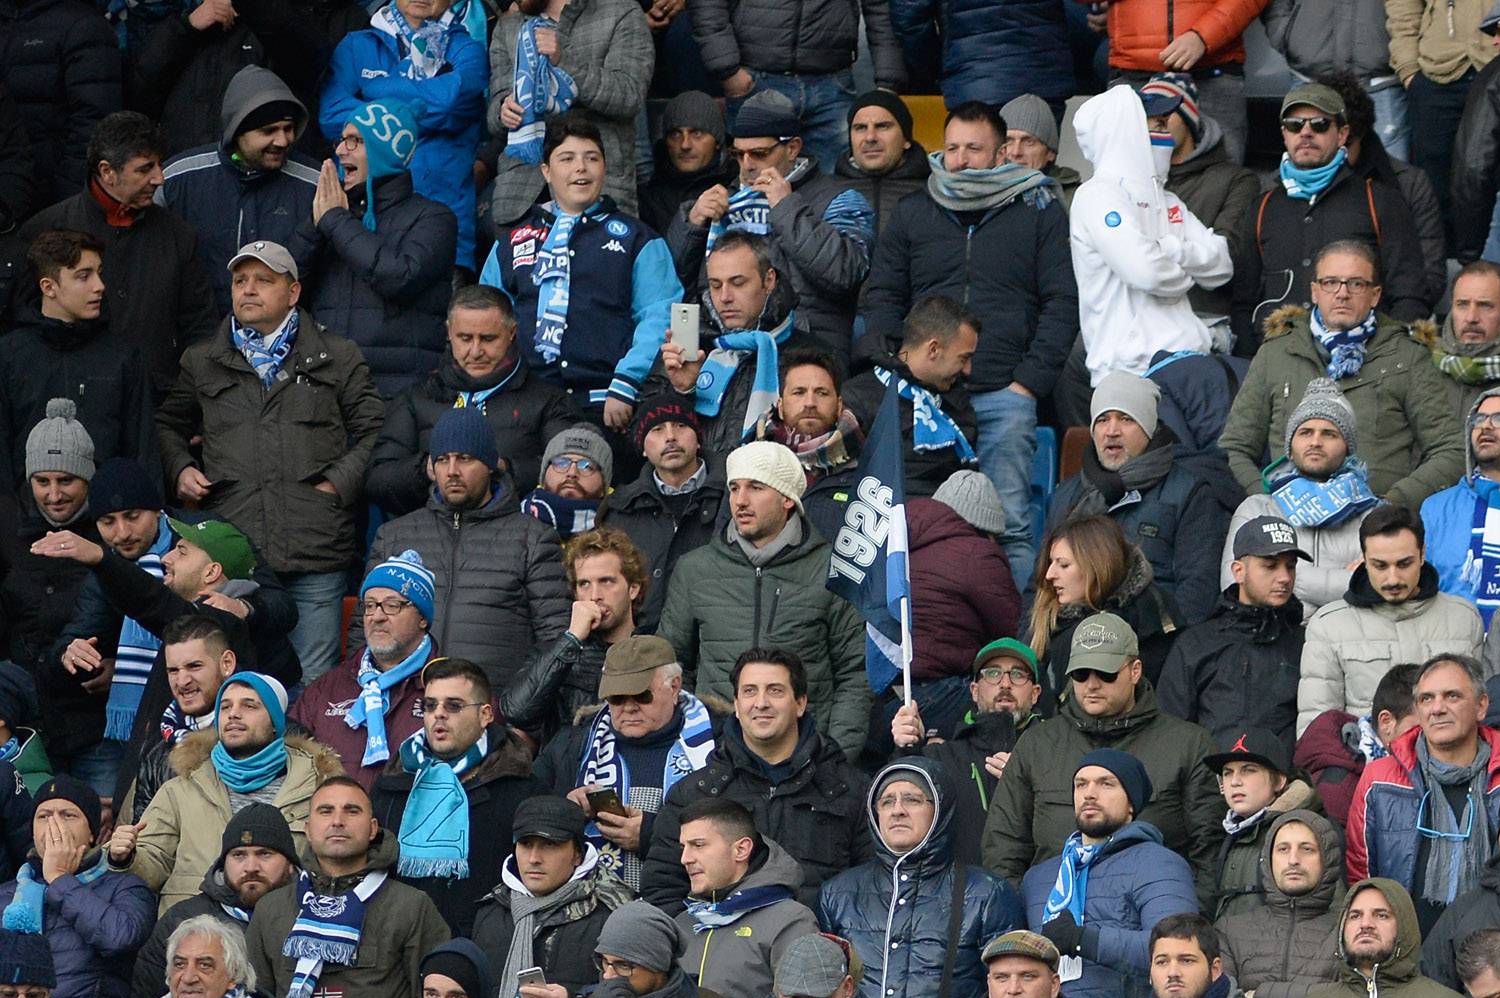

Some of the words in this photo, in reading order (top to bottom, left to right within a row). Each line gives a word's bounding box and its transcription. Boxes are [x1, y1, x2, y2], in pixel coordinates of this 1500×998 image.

[355, 104, 415, 158] SSC
[829, 476, 893, 584] 1926
[1262, 523, 1278, 533] MAI
